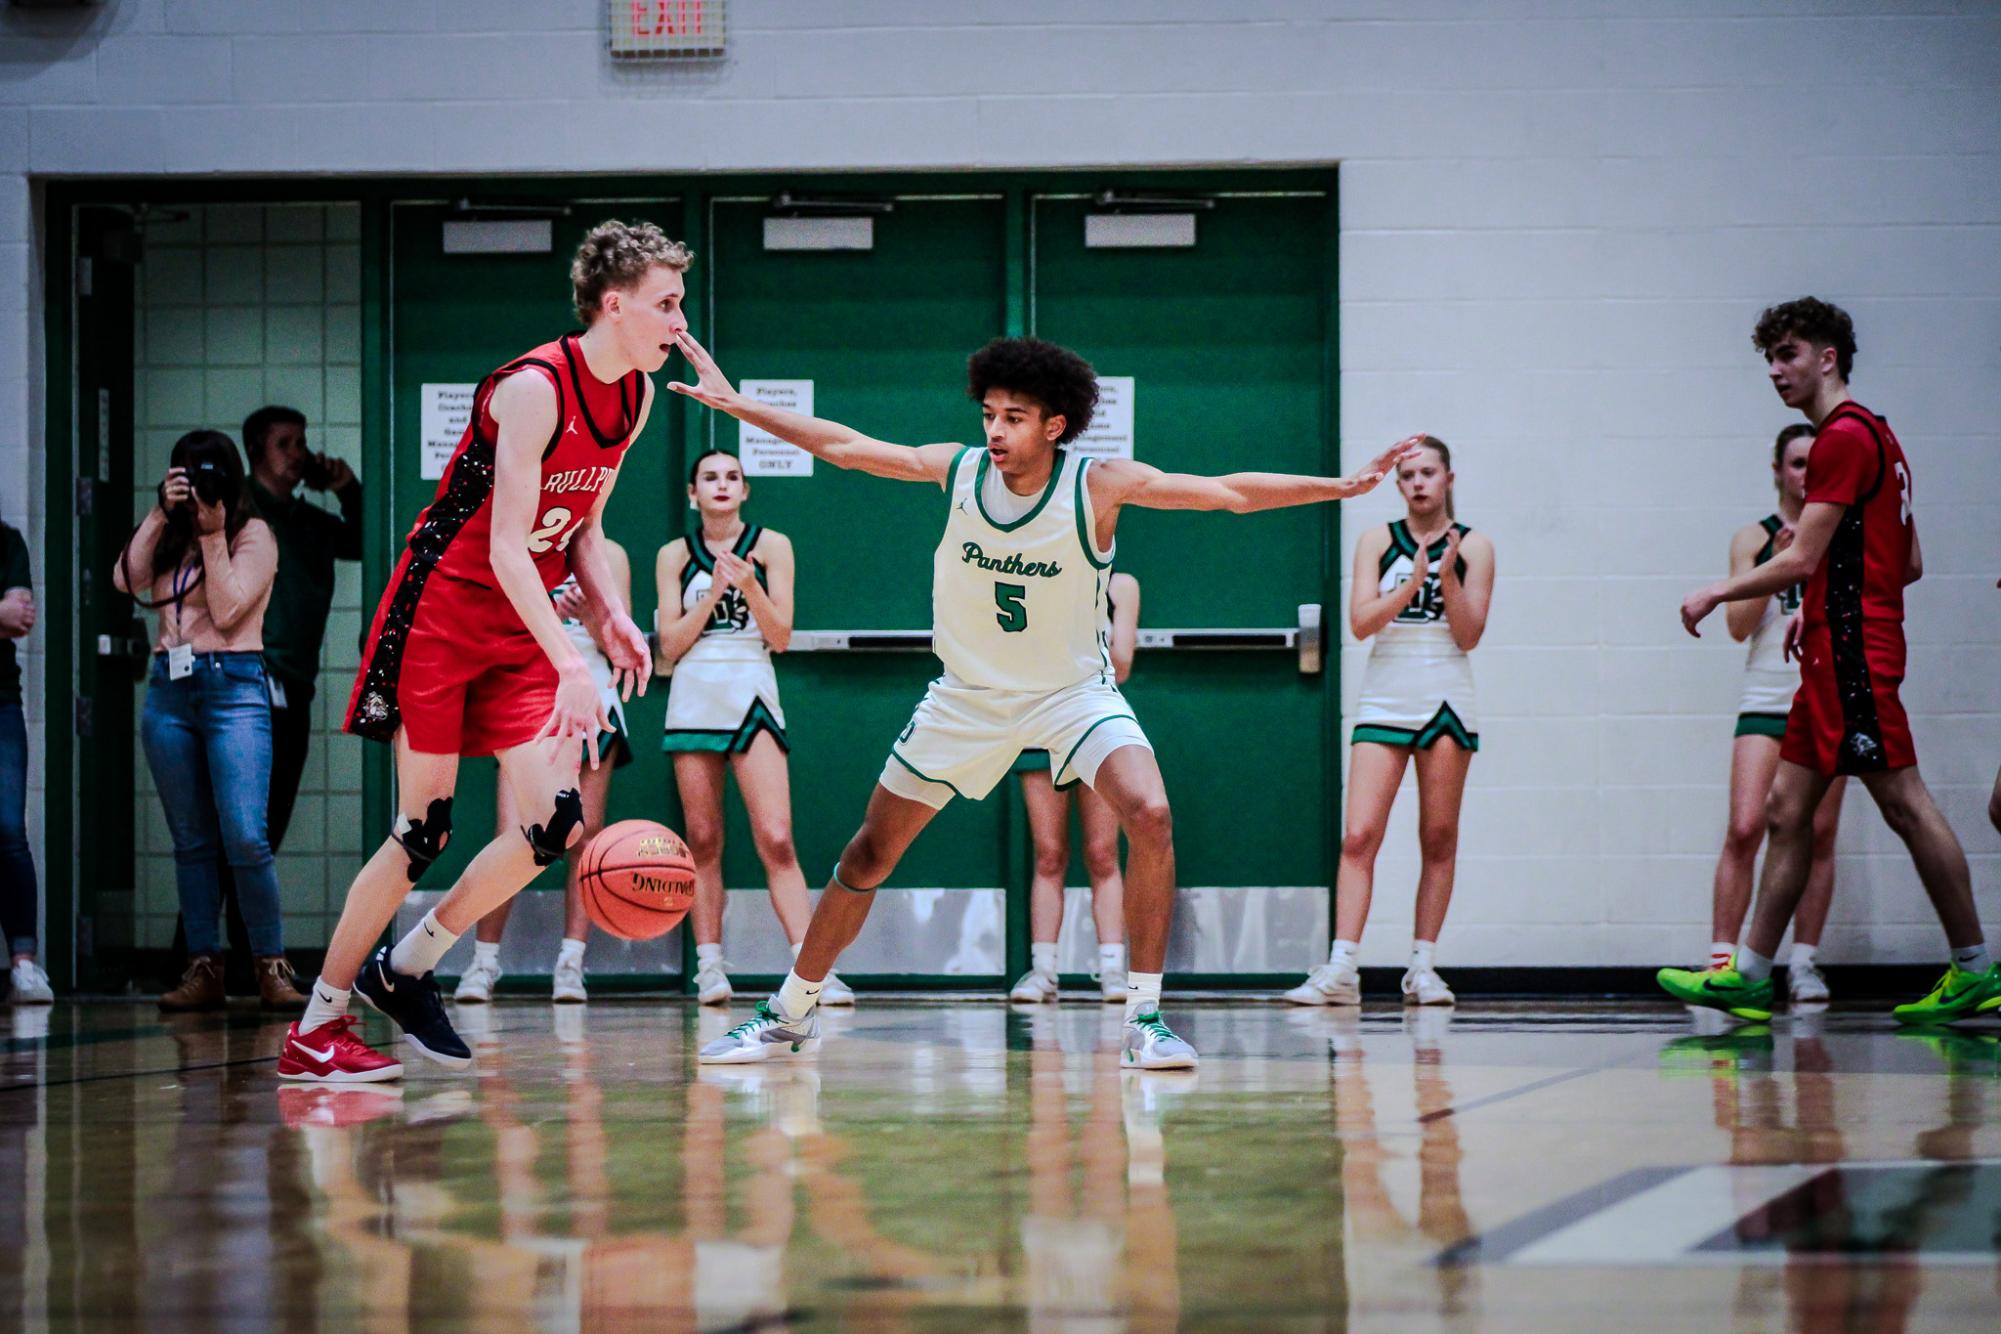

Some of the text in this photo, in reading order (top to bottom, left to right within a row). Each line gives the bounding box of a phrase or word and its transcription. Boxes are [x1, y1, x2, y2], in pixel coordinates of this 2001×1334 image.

[632, 0, 703, 37] EXIT
[758, 460, 793, 469] ONLY
[961, 541, 1063, 578] Panthers
[994, 580, 1029, 633] 5
